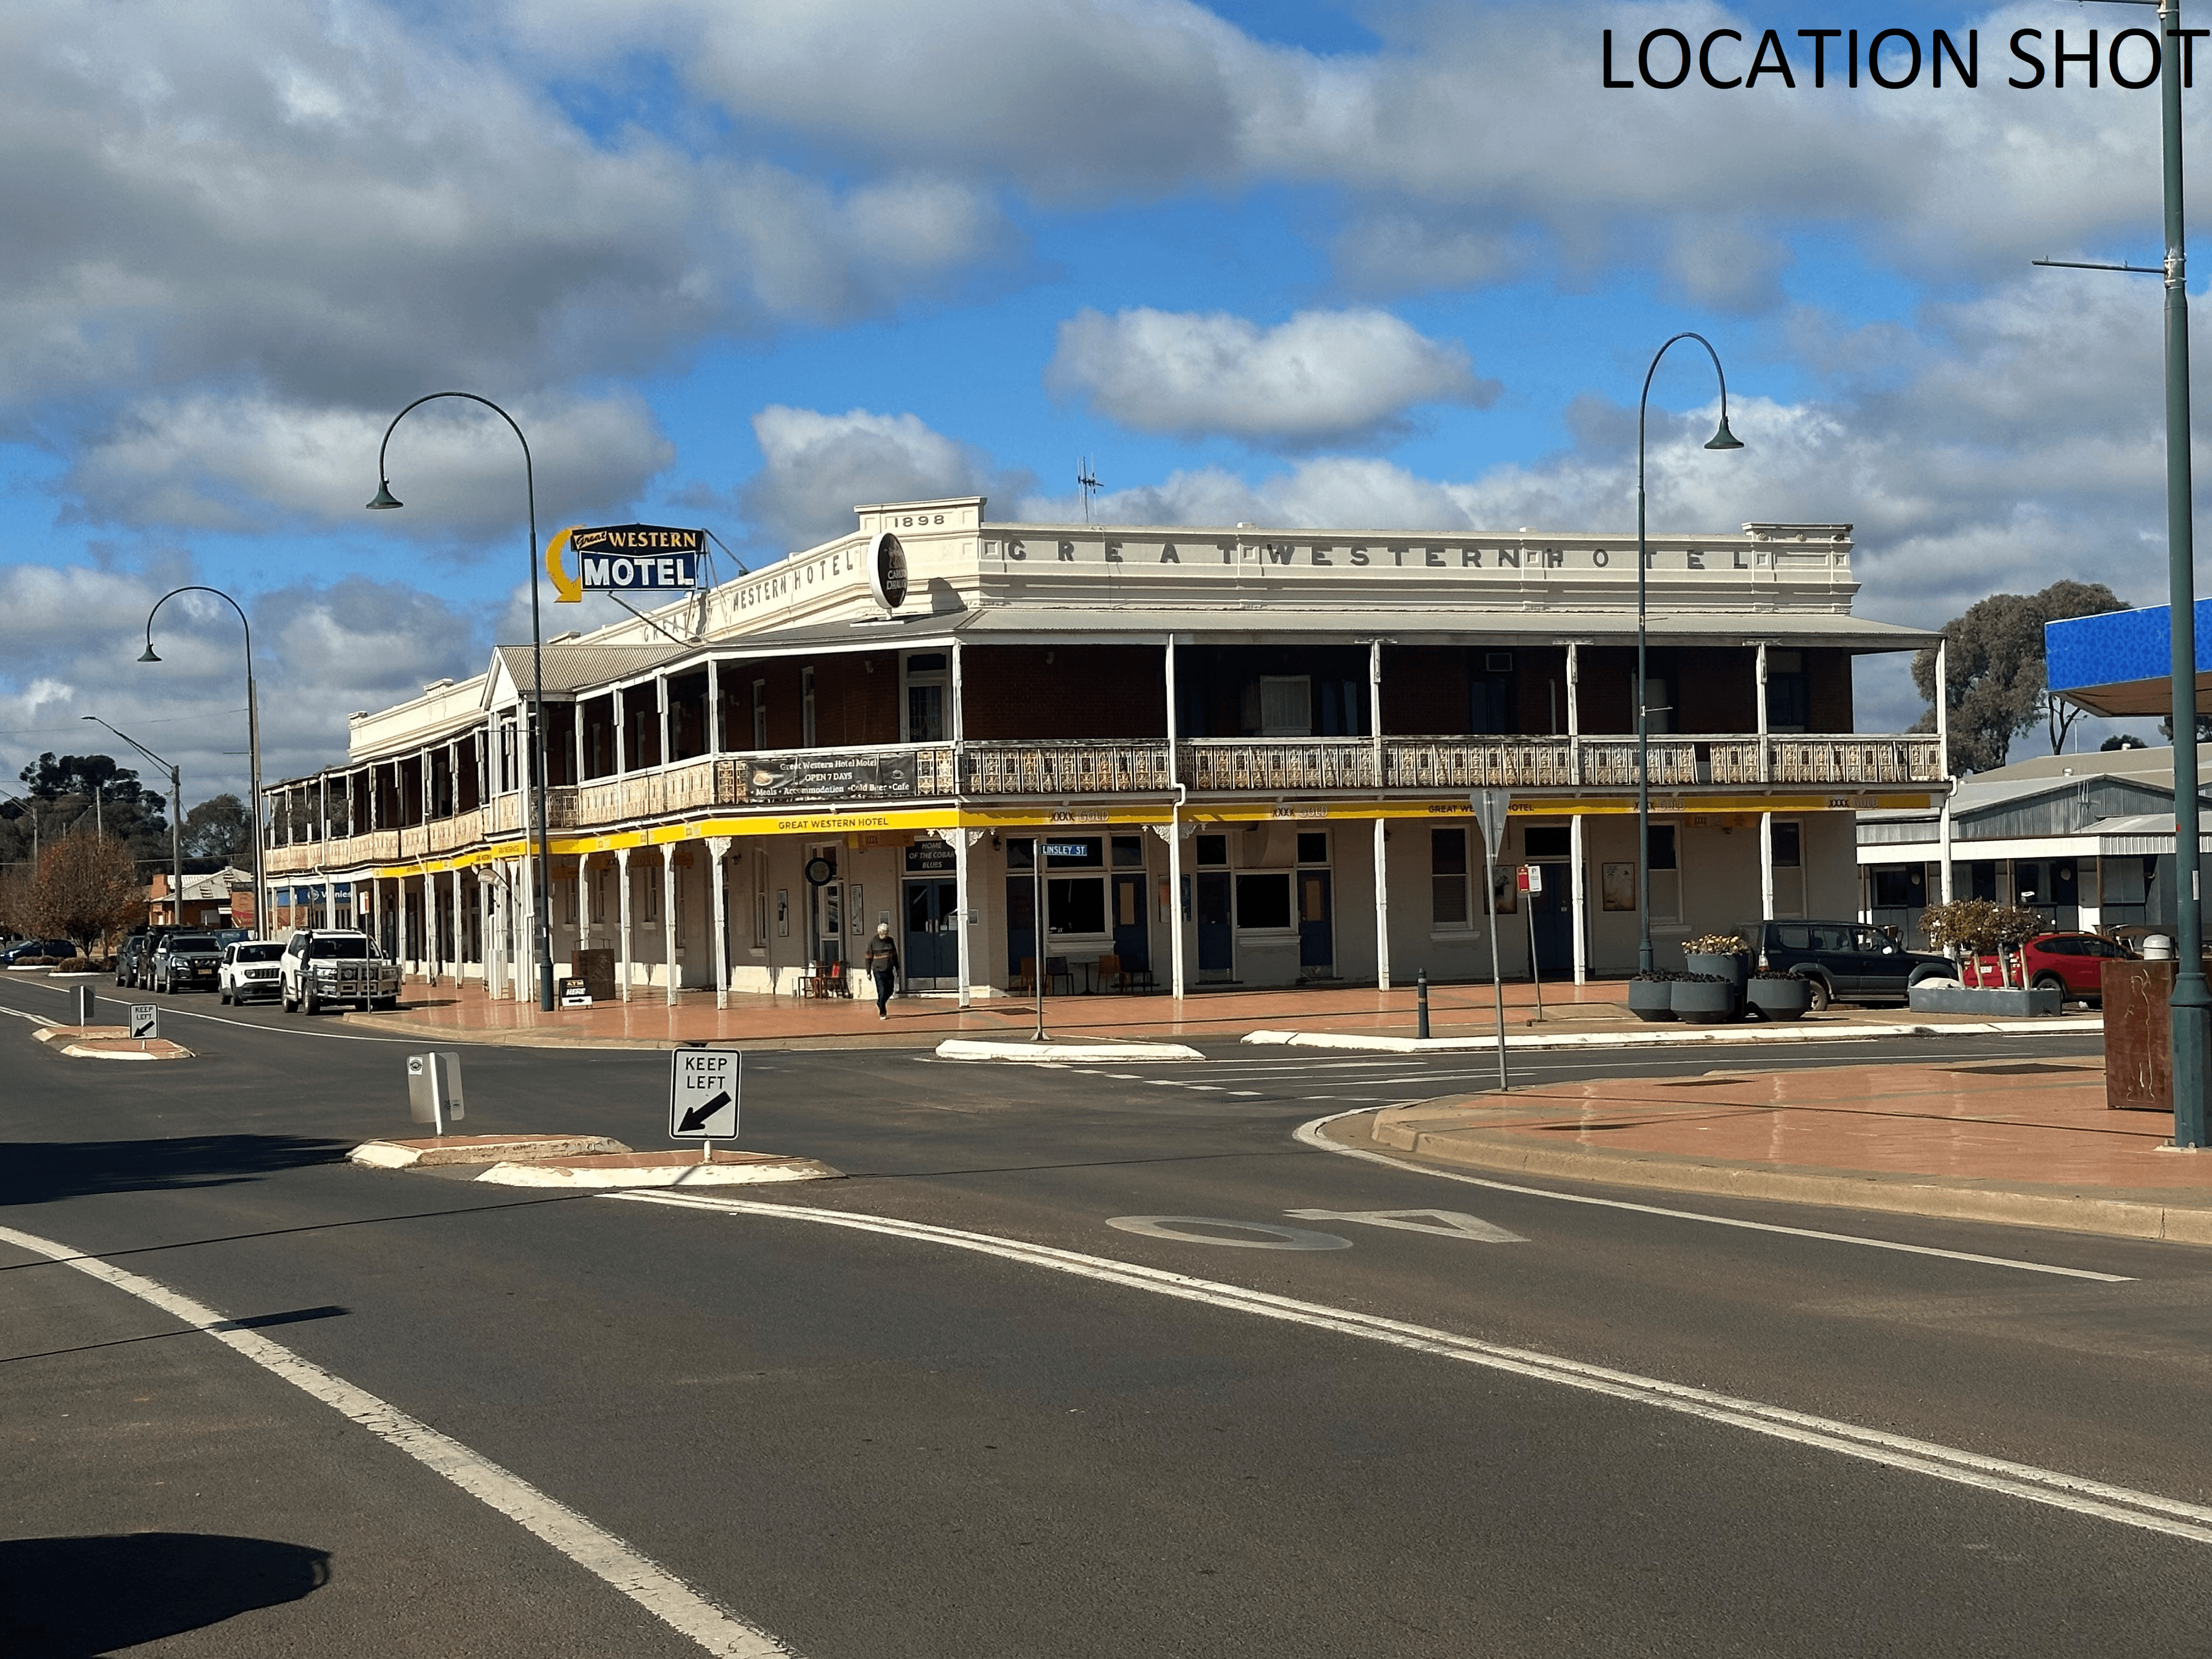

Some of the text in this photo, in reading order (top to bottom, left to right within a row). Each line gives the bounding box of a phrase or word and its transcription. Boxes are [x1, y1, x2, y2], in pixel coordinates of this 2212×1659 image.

[895, 514, 944, 528] 1898
[577, 531, 696, 547] Great WESTERN
[1008, 539, 1748, 570] GREAT WESTERN HOTEL
[584, 558, 695, 586] MOTEL
[733, 575, 787, 612] WESTERN
[794, 551, 853, 590] HOTEL
[780, 758, 877, 771] Great Western Hotel Motel
[805, 773, 828, 782] OPEN
[833, 772, 853, 781] DAYS
[756, 787, 777, 796] Meals
[783, 785, 844, 795] Accommodation
[850, 783, 868, 791] Cold
[869, 783, 887, 791] Beer
[1429, 805, 1457, 813] GREAT
[1660, 799, 1686, 812] GOLD
[1829, 797, 1878, 808] XXXX GOLD
[1050, 810, 1109, 823] XXXX GOLD
[1273, 806, 1328, 818] XXXX GOLD
[778, 817, 889, 830] GREAT WESTERN HOTEL
[1043, 845, 1085, 854] LINSLEY ST
[566, 987, 586, 995] HERE
[685, 1057, 728, 1071] KEEP
[687, 1075, 726, 1089] LEFT
